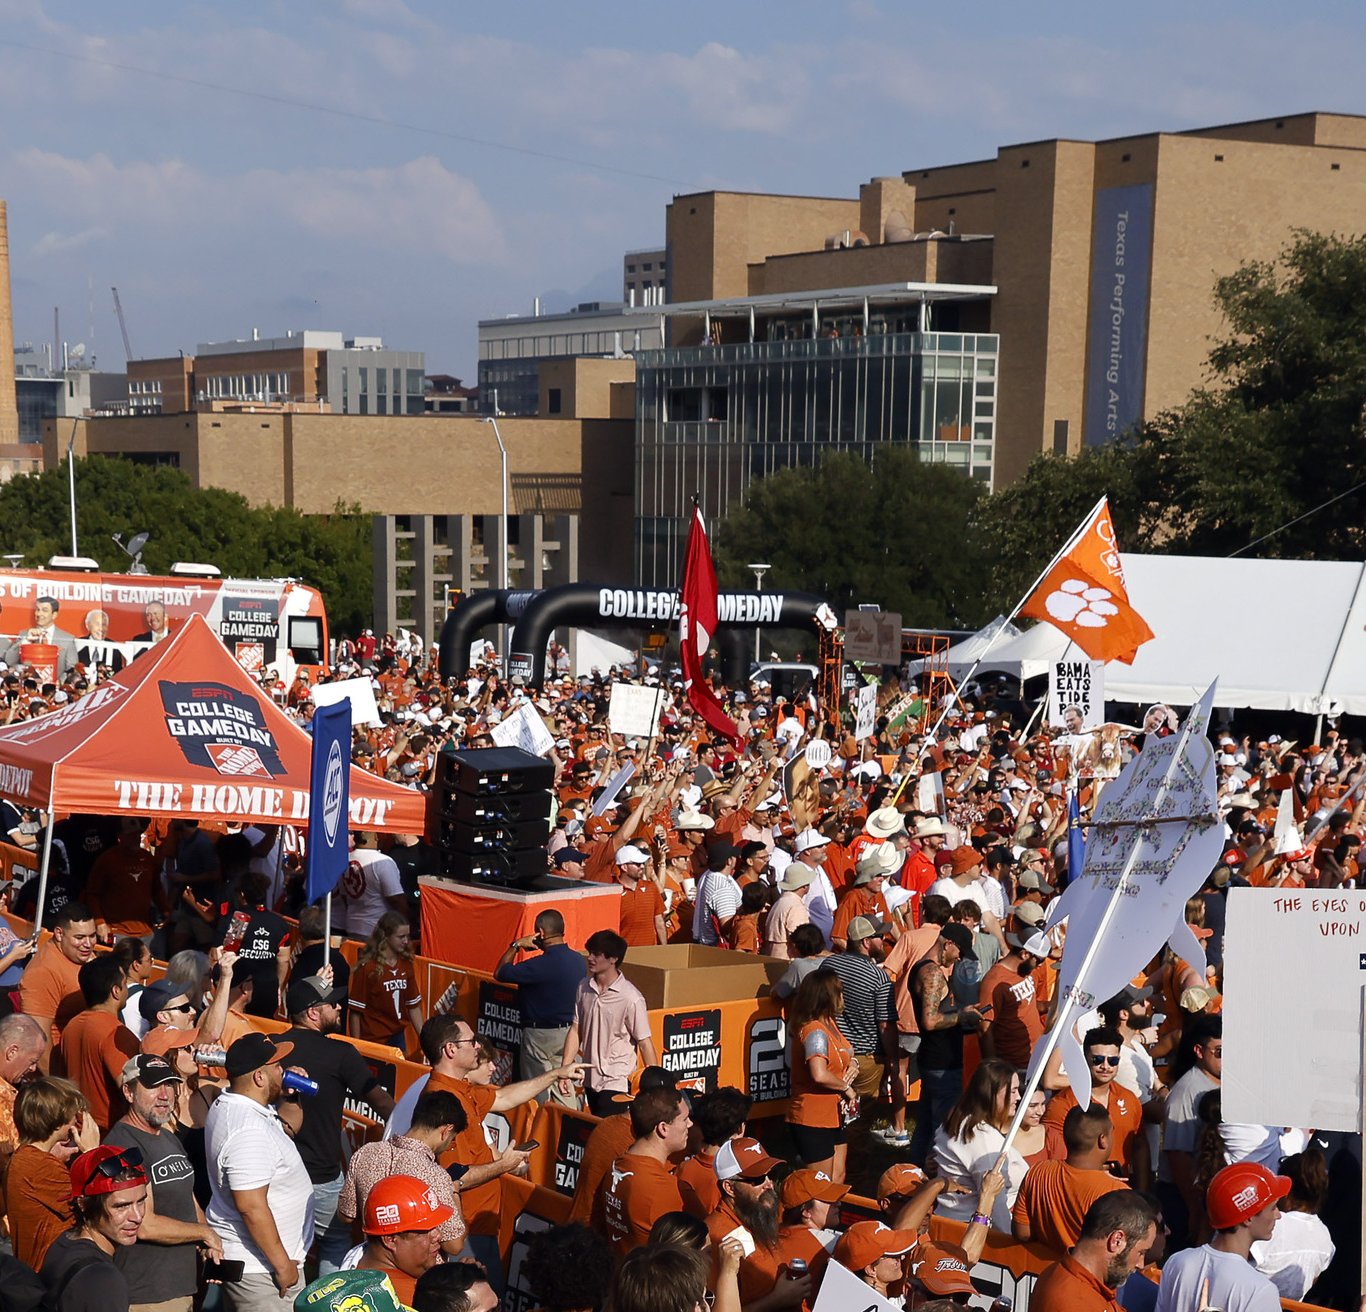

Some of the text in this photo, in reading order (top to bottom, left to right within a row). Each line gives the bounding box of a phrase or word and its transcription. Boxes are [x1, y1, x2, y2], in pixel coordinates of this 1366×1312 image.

[1115, 210, 1129, 267] Texas
[1105, 272, 1127, 382] Performing
[10, 580, 32, 599] OF
[35, 582, 113, 603] BUILDING
[117, 586, 195, 606] GAMEDAY
[600, 588, 784, 622] COLLEGE MEDAY
[228, 611, 272, 624] COLLEGE
[221, 623, 279, 638] GAMEDAY
[1055, 662, 1091, 678] BAMA
[1056, 677, 1091, 691] EATS
[191, 687, 233, 701] ESPN
[1057, 691, 1090, 704] TIDE
[176, 701, 257, 726] COLLEGE
[1059, 703, 1091, 717] PS
[167, 718, 272, 747] GAMEDAY
[114, 781, 395, 826] THE HOME DOT
[1273, 897, 1302, 913] THE
[1312, 898, 1349, 913] EYES
[1319, 921, 1361, 937] UPON
[253, 939, 270, 951] CSG
[383, 979, 408, 992] TEXAS
[392, 990, 402, 1020] 1
[485, 1001, 521, 1024] COLLEGE
[680, 1016, 704, 1030] ESPN
[669, 1030, 714, 1051] COLLEGE
[662, 1047, 720, 1072] GAMEDAY
[750, 1072, 789, 1092] SEAS
[376, 1203, 400, 1219] 20
